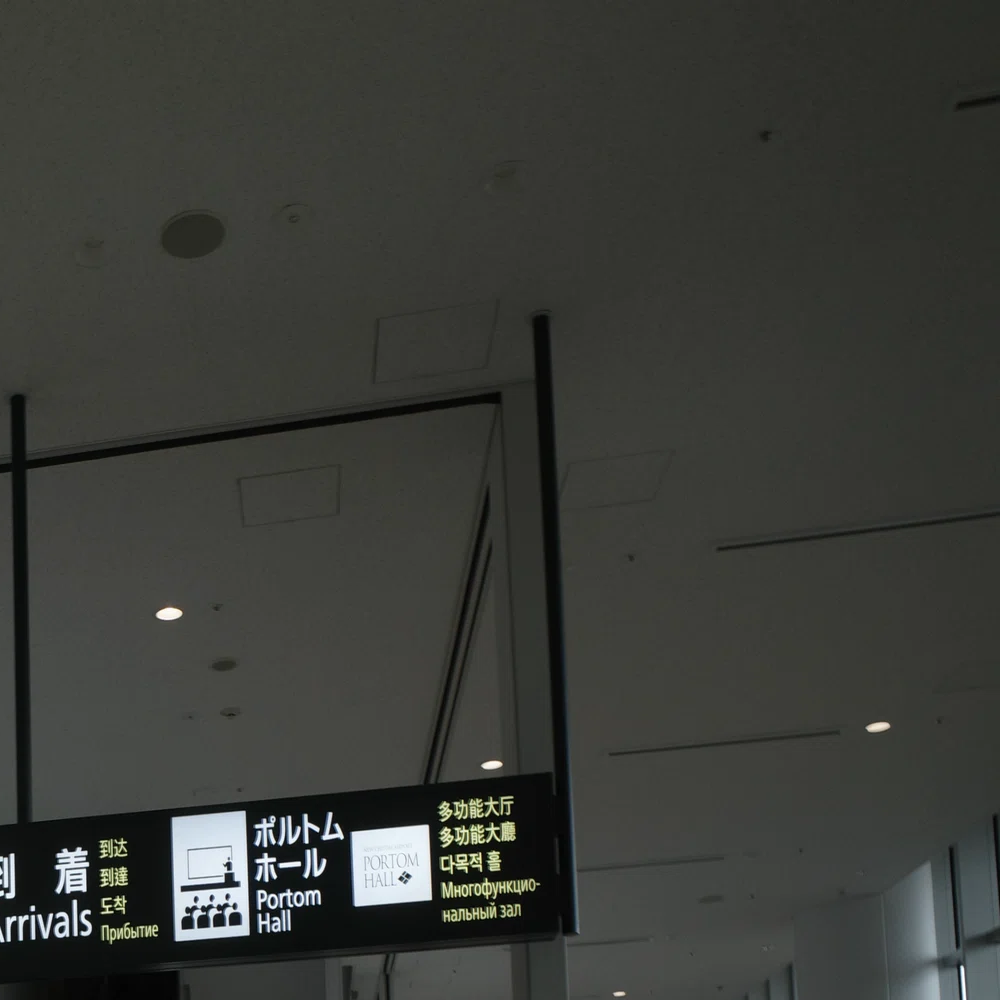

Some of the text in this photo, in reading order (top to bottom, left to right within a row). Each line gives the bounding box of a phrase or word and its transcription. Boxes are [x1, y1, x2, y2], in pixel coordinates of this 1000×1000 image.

[438, 796, 514, 822] 多功能大厅
[253, 812, 344, 848] ポルトム
[439, 821, 516, 848] 多功能大廳
[99, 838, 127, 858] 到达
[254, 848, 327, 882] ホール
[363, 852, 419, 871] PORTOM
[440, 850, 501, 874] 다목적 홀
[100, 866, 128, 887] 到達
[364, 871, 397, 888] HALL
[441, 878, 540, 899] Многофункцио-
[101, 895, 127, 914] 도착
[256, 889, 321, 910] Portom
[257, 909, 291, 933] Hall
[443, 902, 521, 922] нальный зал
[101, 922, 158, 944] Прибытие
